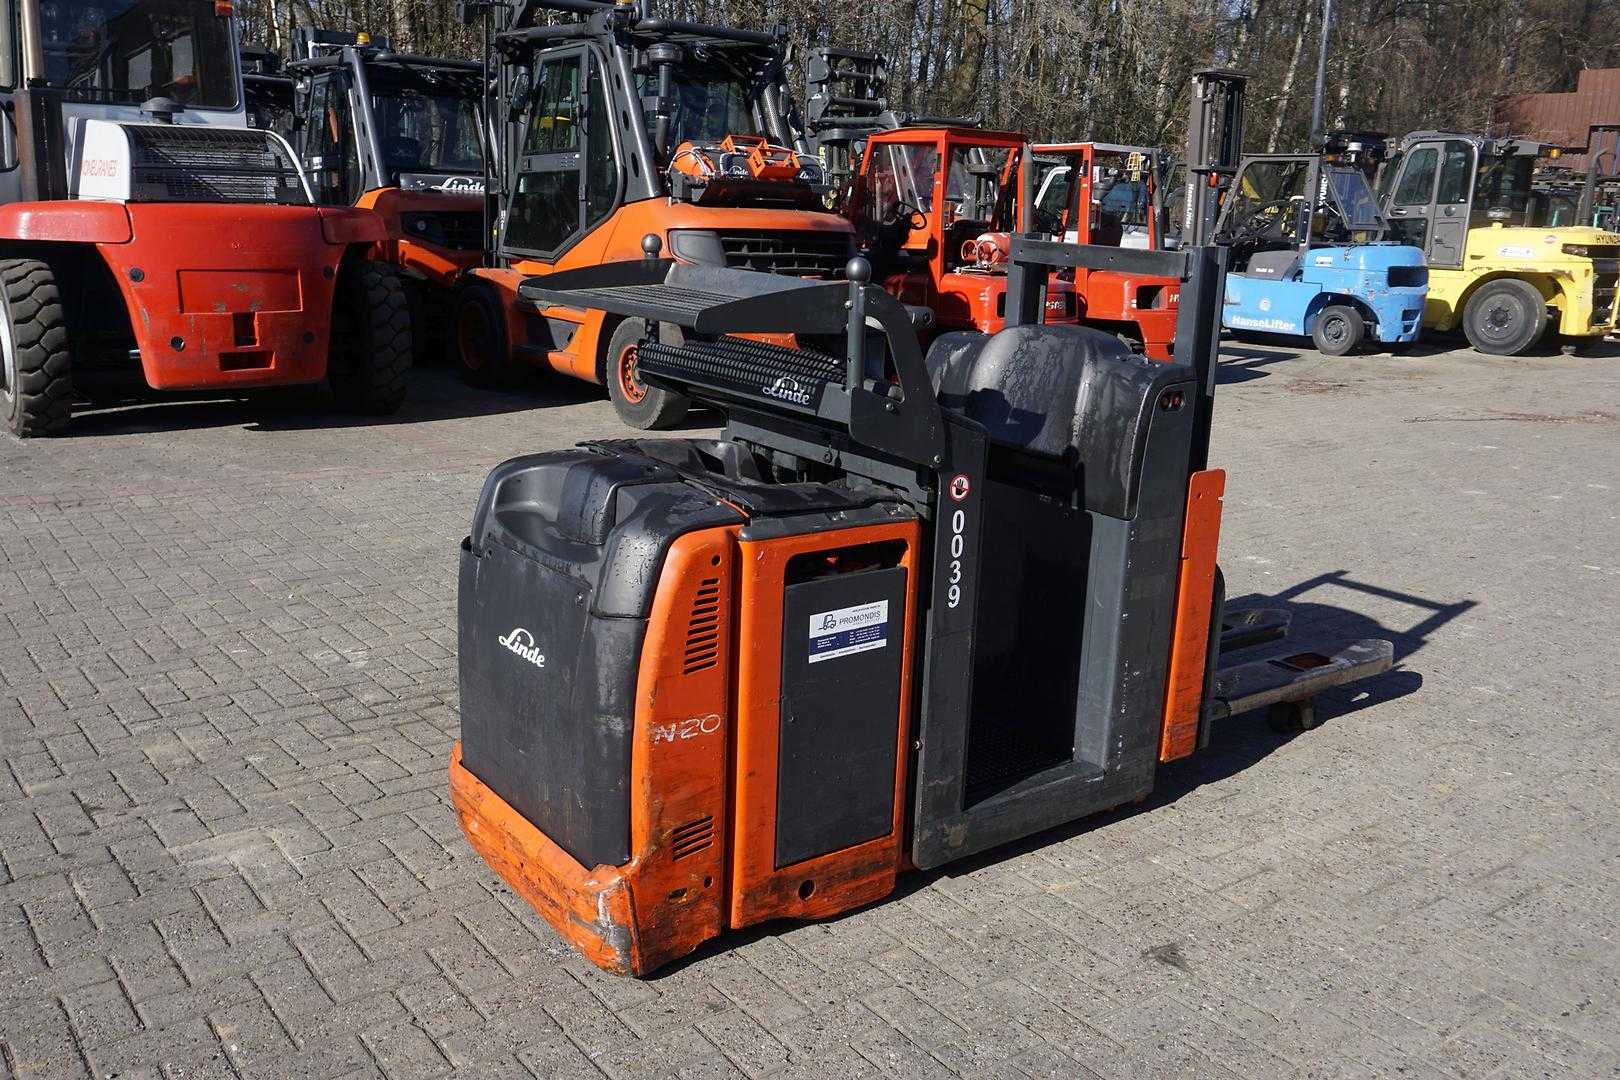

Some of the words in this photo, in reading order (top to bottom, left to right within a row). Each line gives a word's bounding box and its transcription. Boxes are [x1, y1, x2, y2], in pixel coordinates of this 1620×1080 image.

[1232, 315, 1296, 330] HanseLifter
[763, 377, 810, 405] Linde
[947, 509, 965, 608] 0039
[839, 610, 881, 625] PROMONDIS
[498, 628, 545, 668] Linde
